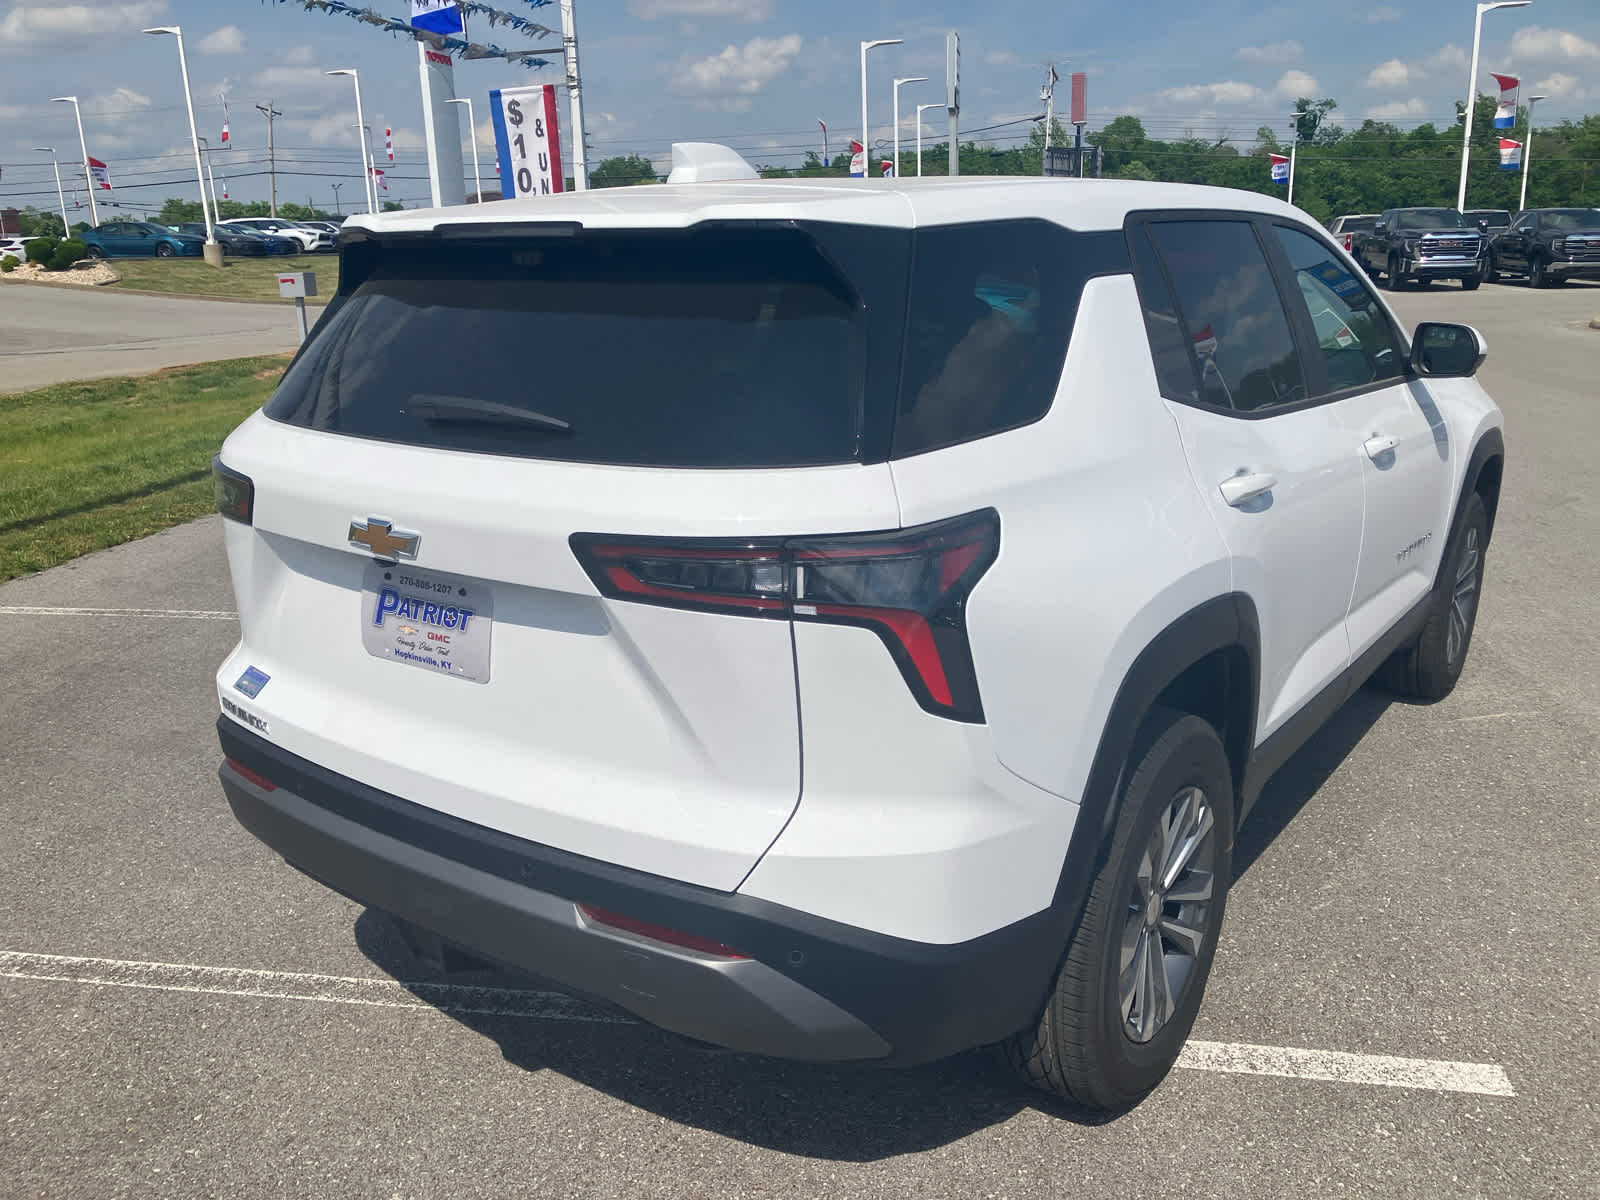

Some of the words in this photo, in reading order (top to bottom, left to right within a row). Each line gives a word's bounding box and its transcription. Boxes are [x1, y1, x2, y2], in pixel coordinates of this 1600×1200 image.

[373, 588, 473, 632] PATRIOT
[427, 631, 451, 645] GMC
[394, 647, 440, 668] Hopkinsville,
[440, 660, 452, 670] KY
